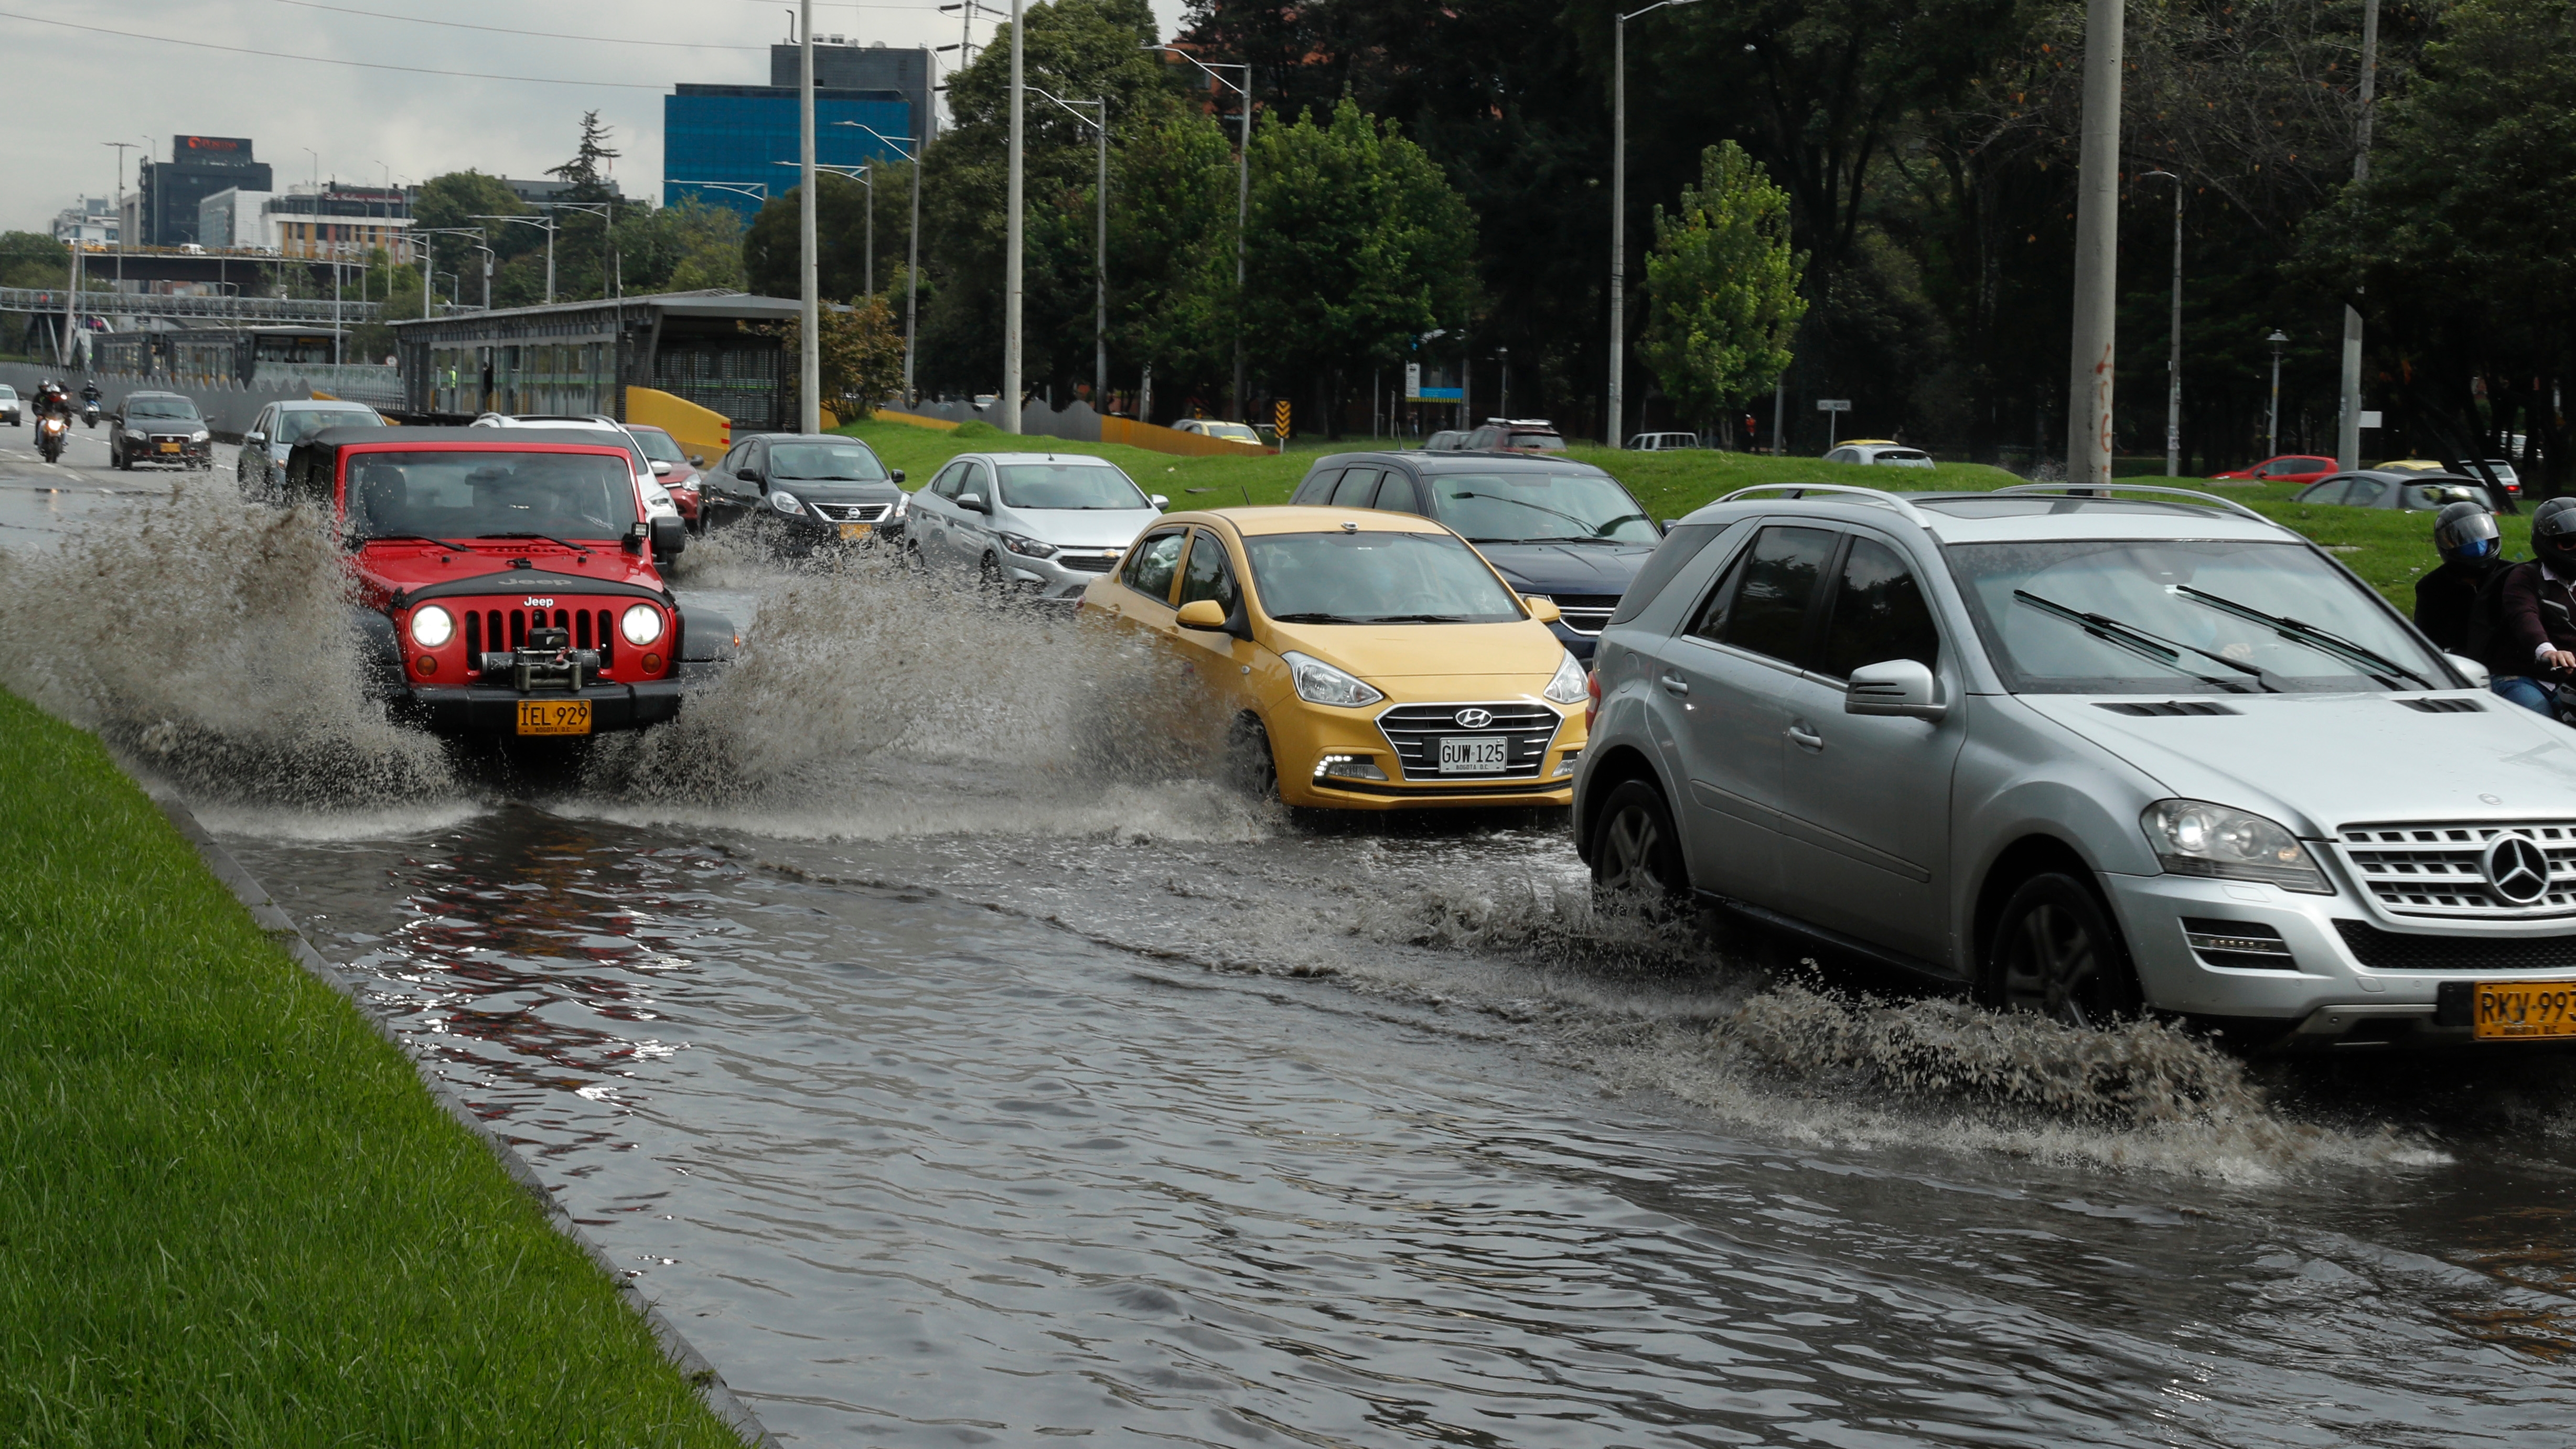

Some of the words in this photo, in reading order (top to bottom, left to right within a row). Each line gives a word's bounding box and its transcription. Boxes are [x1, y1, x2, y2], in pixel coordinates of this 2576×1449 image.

[523, 596, 554, 608] Jeep
[521, 707, 551, 726] IEL
[557, 706, 588, 725] 929
[1442, 744, 1471, 763] GUW
[1476, 744, 1504, 763] 125
